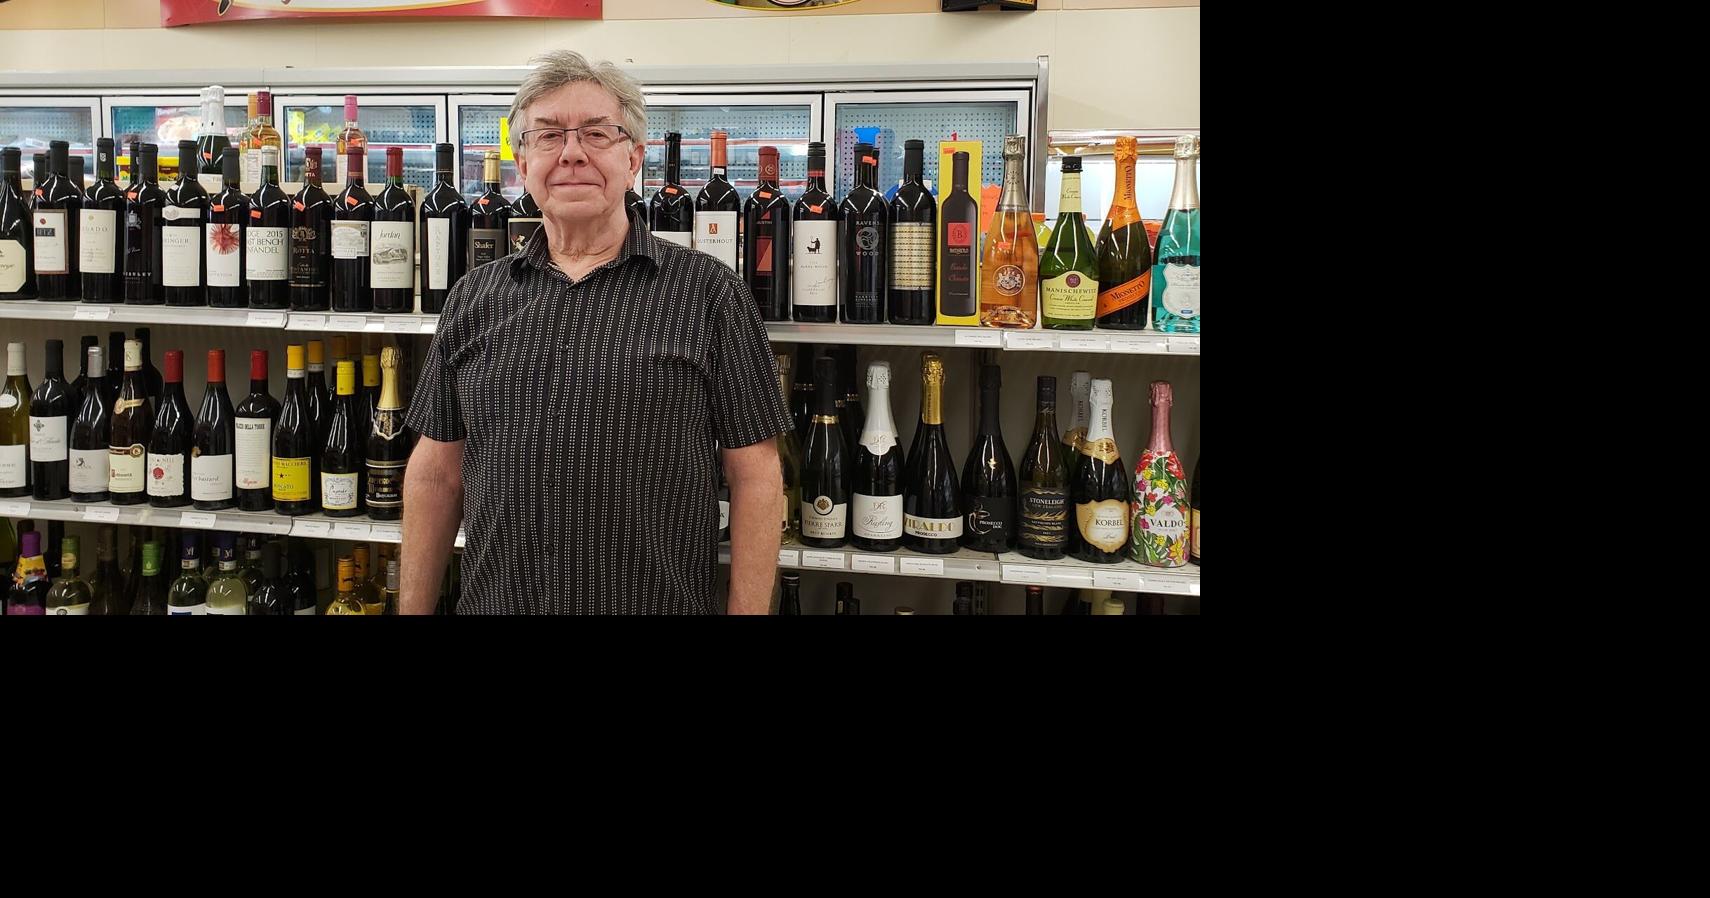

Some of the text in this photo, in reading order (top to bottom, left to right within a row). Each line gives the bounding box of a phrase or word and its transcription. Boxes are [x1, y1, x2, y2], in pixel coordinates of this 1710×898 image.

[266, 230, 284, 238] 2015
[256, 238, 284, 246] BENCH
[474, 241, 495, 249] Shafer
[1110, 280, 1146, 301] MIONETTO
[1029, 497, 1065, 505] STONELEIGH
[1150, 519, 1184, 528] VALDO
